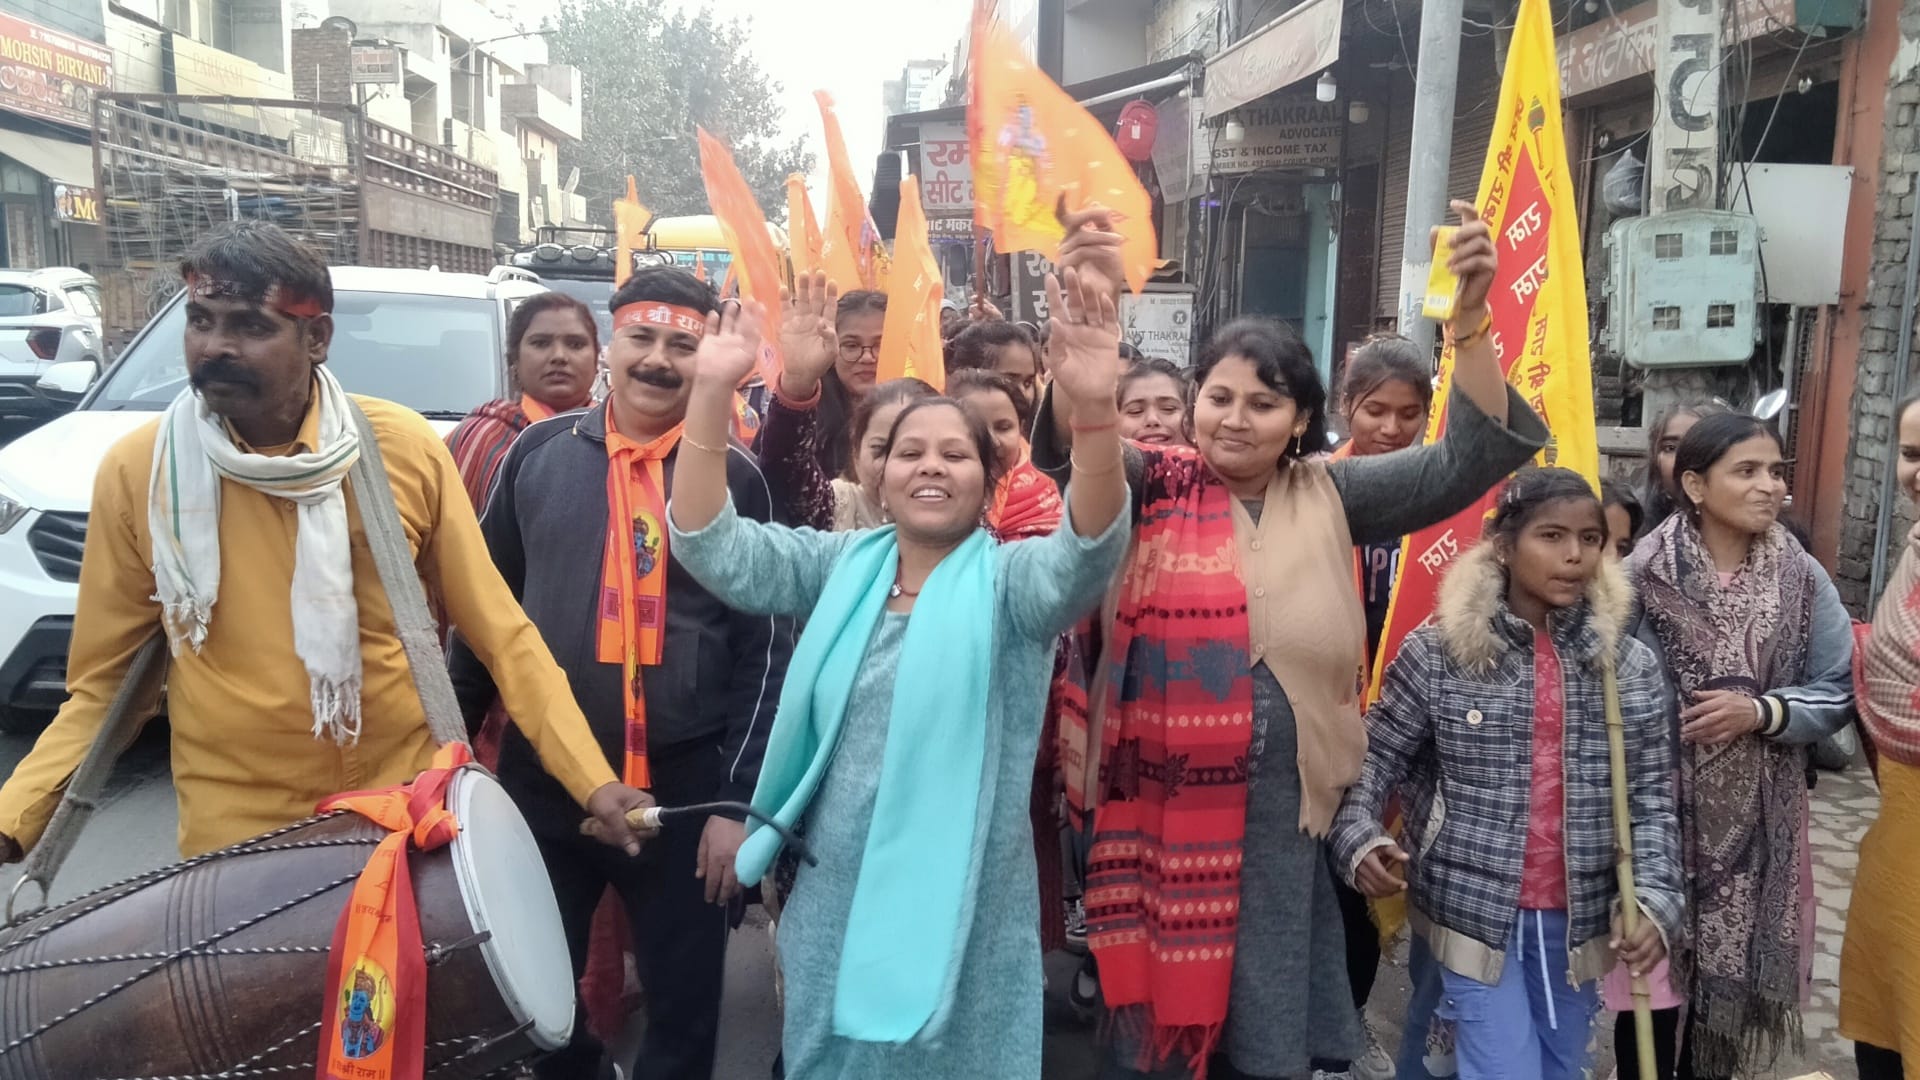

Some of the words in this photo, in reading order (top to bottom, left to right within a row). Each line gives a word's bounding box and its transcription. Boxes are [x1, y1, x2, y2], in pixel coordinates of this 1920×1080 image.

[0, 35, 52, 71] MOHSIN
[55, 52, 103, 86] BIRYANI
[1247, 103, 1343, 127] THAKRAAL
[1279, 126, 1343, 139] ADVOCATE
[1213, 147, 1236, 158] GST
[1240, 147, 1249, 157] &
[1253, 144, 1300, 156] INCOME
[1304, 143, 1328, 153] TAX
[925, 170, 963, 204] सीट
[647, 306, 673, 324] श्री
[1148, 330, 1190, 341] THAKRAL
